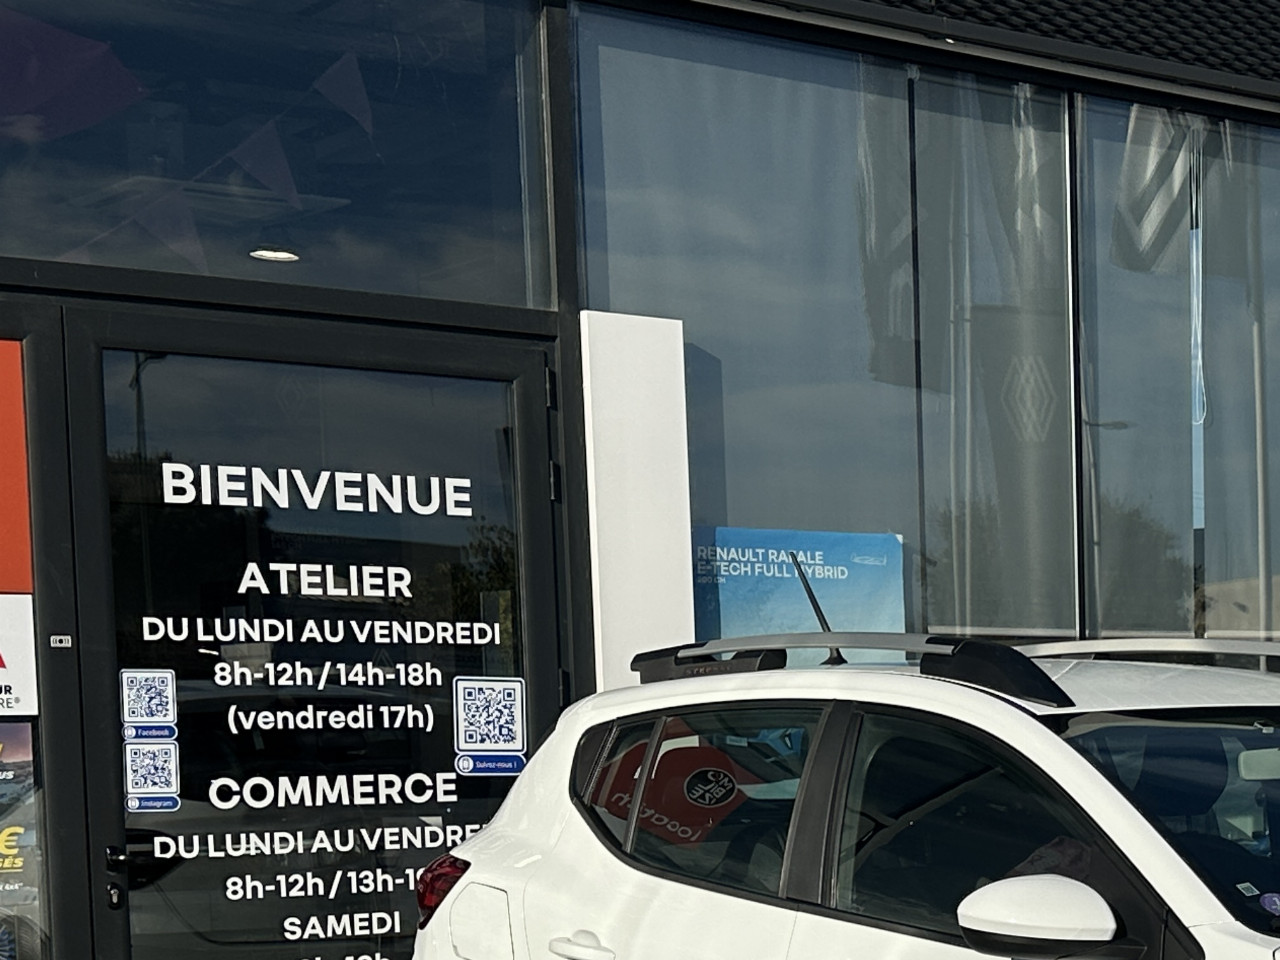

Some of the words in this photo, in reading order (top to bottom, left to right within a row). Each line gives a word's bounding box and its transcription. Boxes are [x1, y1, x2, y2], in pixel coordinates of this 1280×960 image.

[162, 463, 473, 517] BIENVENUE
[697, 545, 765, 562] RENAULT
[238, 563, 413, 598] ATELIER
[697, 561, 751, 576] E-TECH
[755, 563, 792, 578] FULL
[143, 617, 189, 642] DU
[197, 618, 294, 643] LUNDI
[301, 620, 345, 643] AU
[350, 621, 501, 645] VENDREDI
[228, 704, 374, 734] (vendredi
[380, 704, 434, 732] 17h)
[209, 773, 458, 810] COMMERCE
[154, 835, 200, 859] DU
[208, 831, 304, 858] LUNDI
[311, 829, 355, 853] AU
[360, 823, 486, 852] VENDRE
[347, 867, 426, 894] 13h-1
[284, 911, 401, 940] SAMEDI
